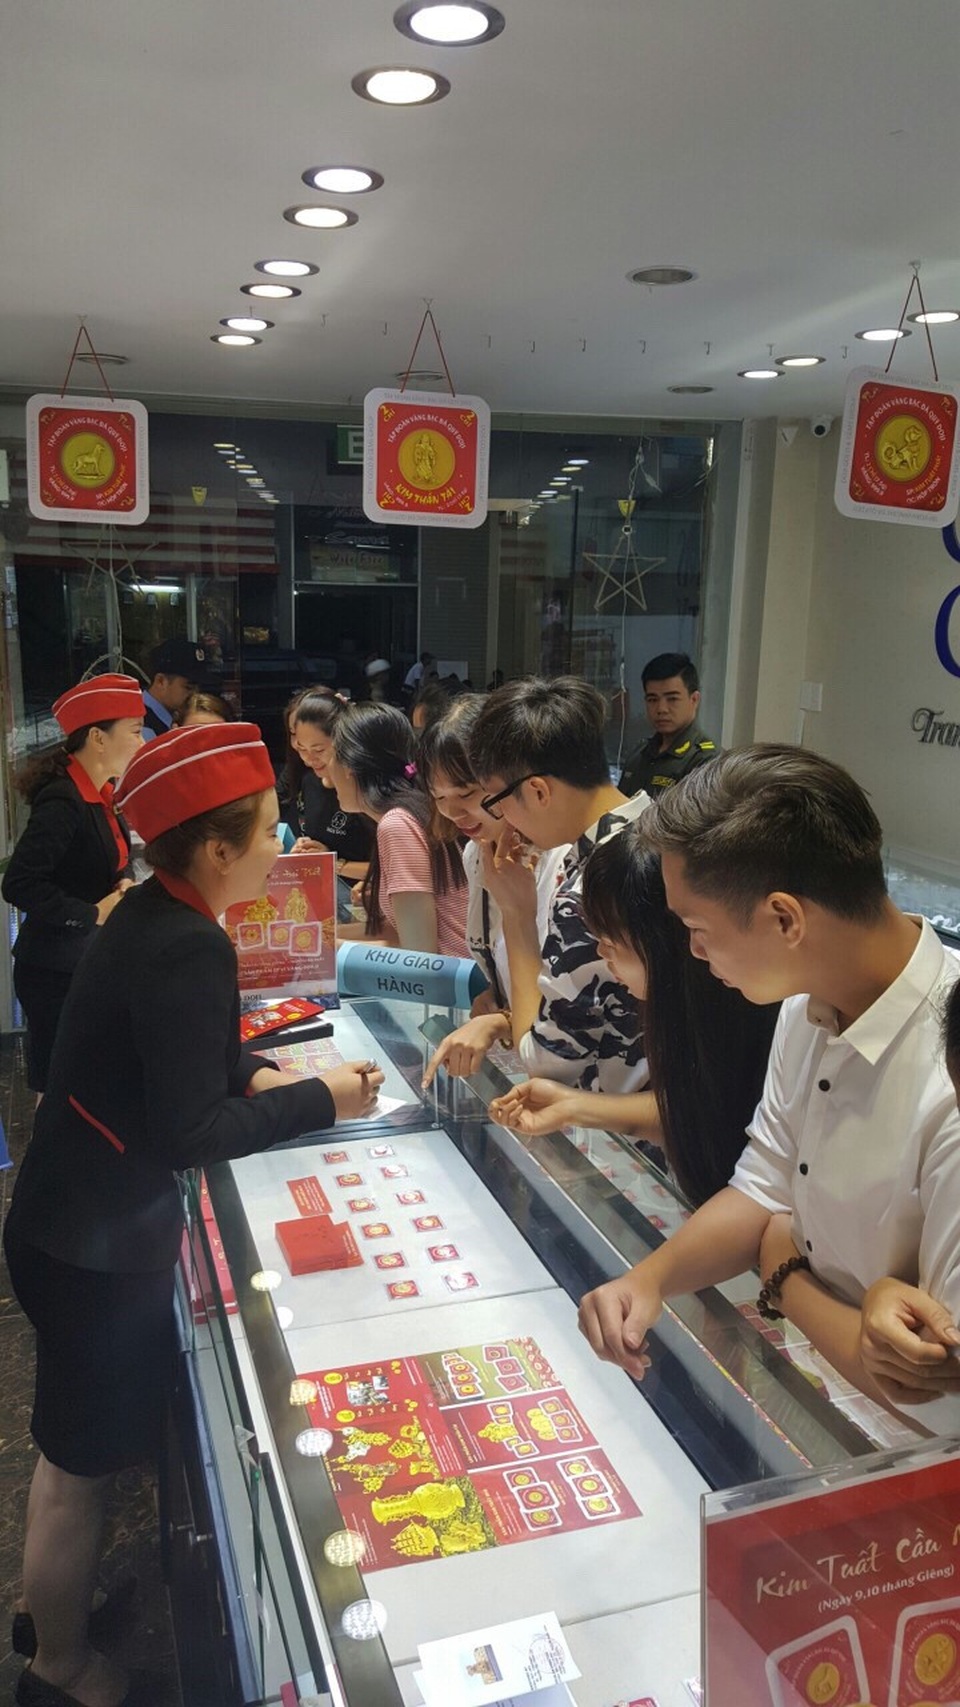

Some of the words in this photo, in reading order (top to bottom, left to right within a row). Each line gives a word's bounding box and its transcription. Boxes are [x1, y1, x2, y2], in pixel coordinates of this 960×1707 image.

[395, 483, 413, 499] KIM
[365, 949, 400, 965] KHU
[400, 955, 445, 971] GIAO
[377, 976, 425, 996] HÀNG
[756, 1570, 811, 1604] Kim
[816, 1541, 886, 1584] Tuất
[896, 1527, 942, 1563] Cầu
[818, 1593, 852, 1613] (Ngày
[882, 1577, 915, 1594] tháng
[917, 1563, 955, 1582] Giêng)
